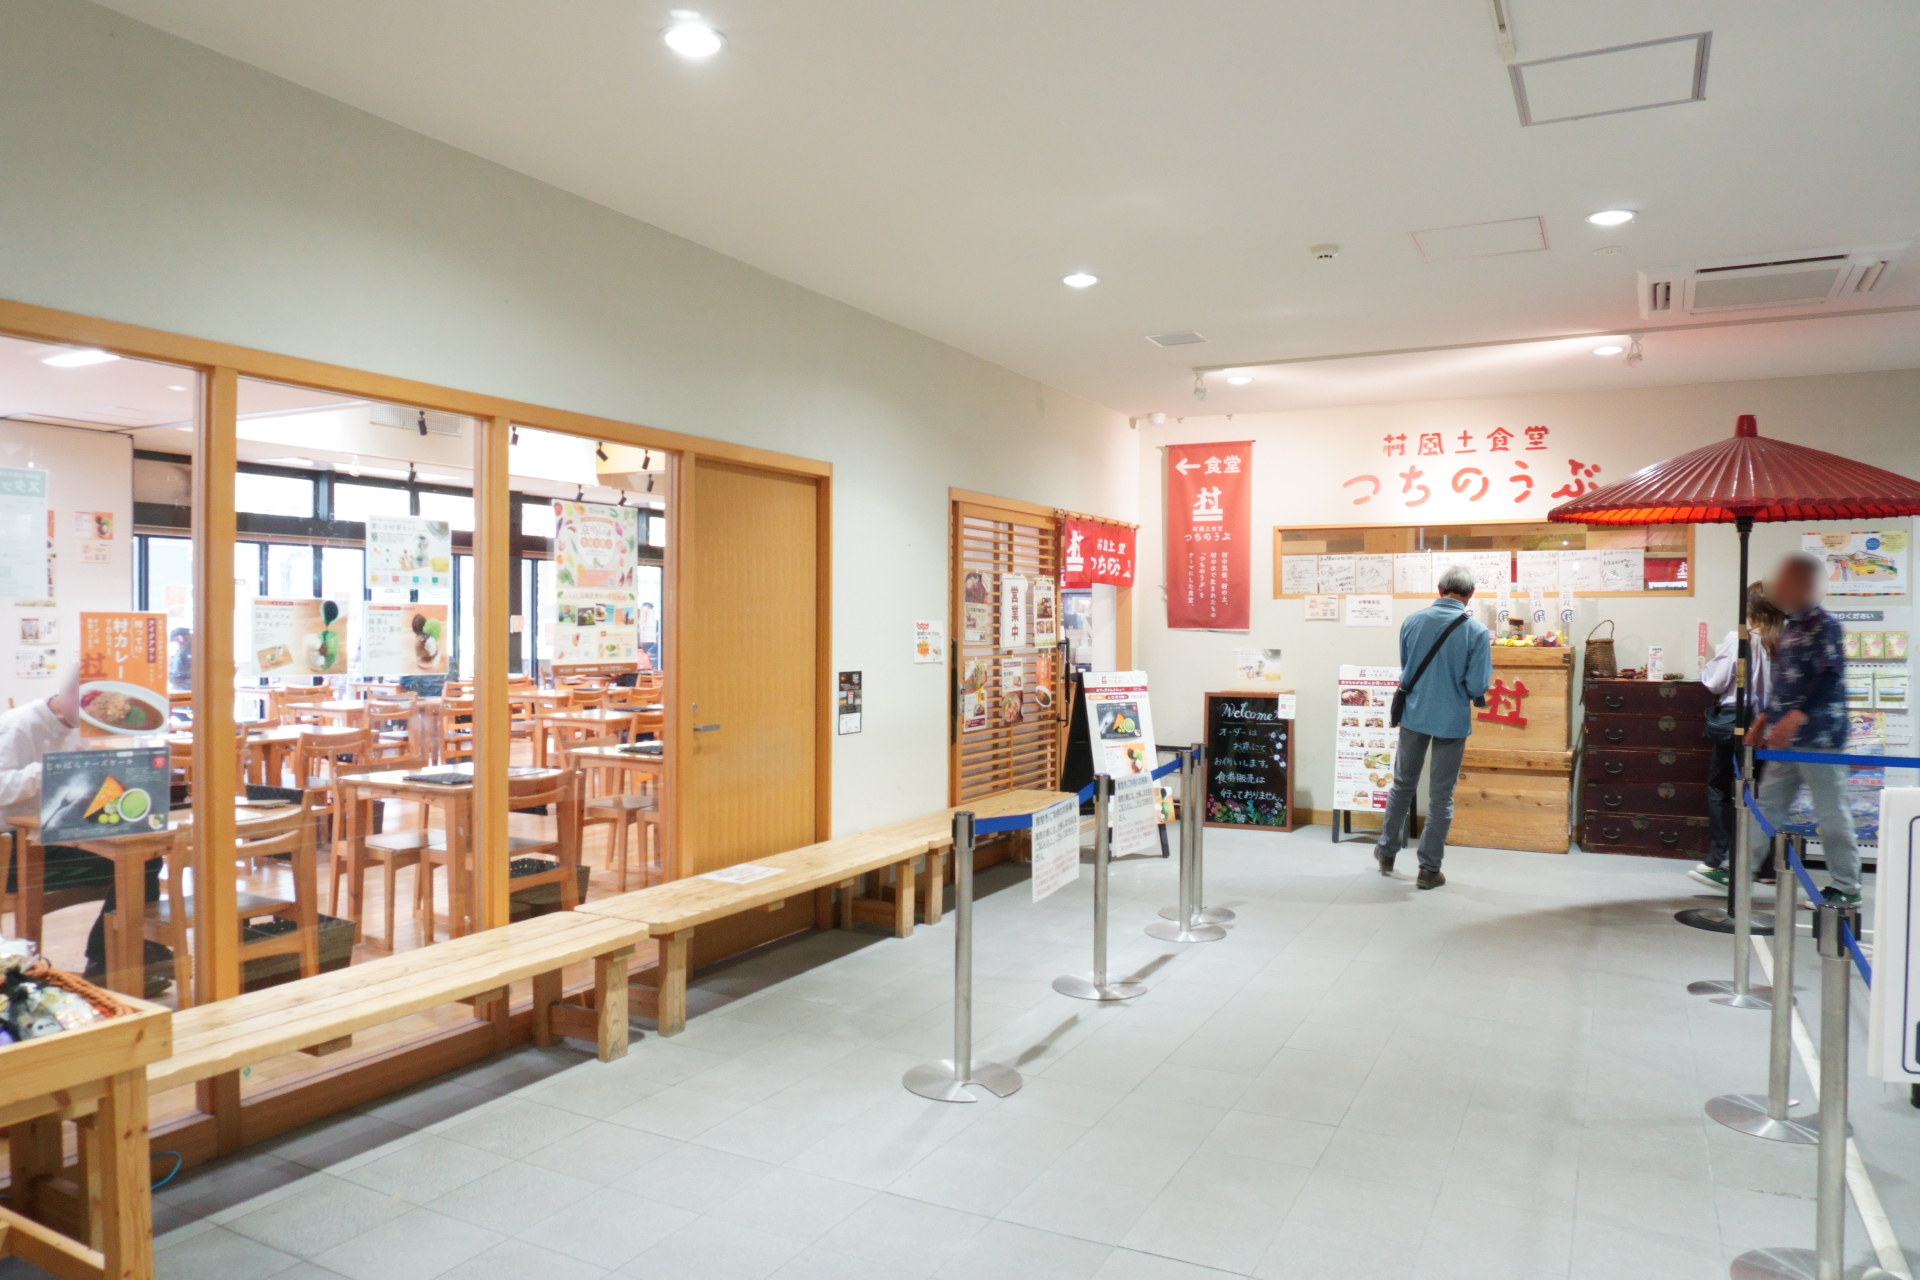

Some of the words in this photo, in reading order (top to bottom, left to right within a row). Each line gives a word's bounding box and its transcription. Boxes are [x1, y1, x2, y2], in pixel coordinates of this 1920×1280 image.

[1204, 455, 1241, 475] 食堂
[1342, 458, 1602, 507] つちのうぶ
[1184, 532, 1231, 542] つちのうぶ
[1011, 585, 1019, 641] 営業中
[113, 617, 129, 679] 村カレー
[148, 620, 156, 661] テイクアウト
[1220, 701, 1276, 721] Welcome
[1218, 727, 1258, 737] オーダーは
[1232, 741, 1267, 752] お席にて
[1214, 757, 1269, 769] お伺いします。
[1215, 771, 1266, 784] 食券販売は
